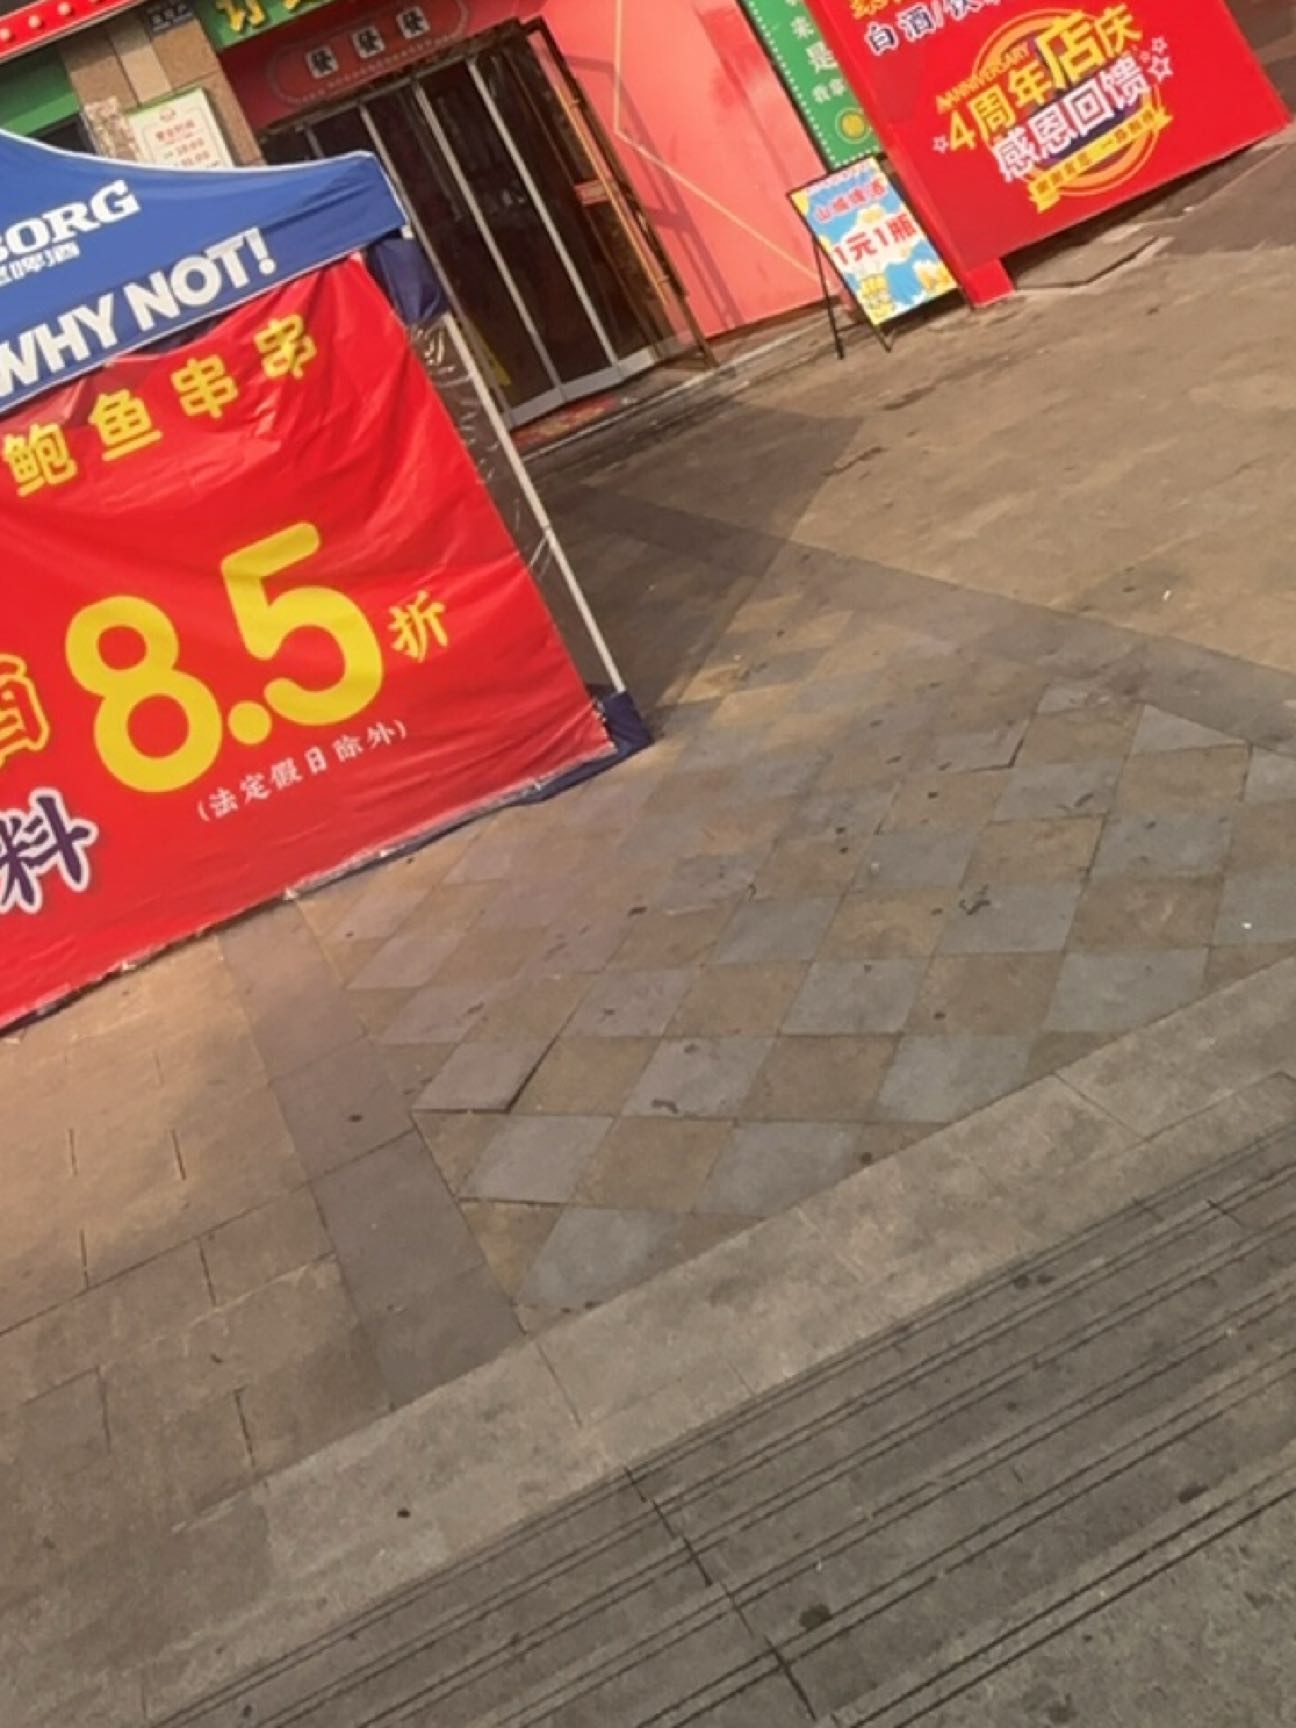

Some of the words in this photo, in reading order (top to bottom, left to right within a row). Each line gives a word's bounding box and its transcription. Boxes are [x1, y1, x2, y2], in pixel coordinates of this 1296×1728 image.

[949, 3, 1144, 153] 4周年店庆
[991, 52, 1151, 183] 感恩回馈
[124, 227, 277, 331] NOT!
